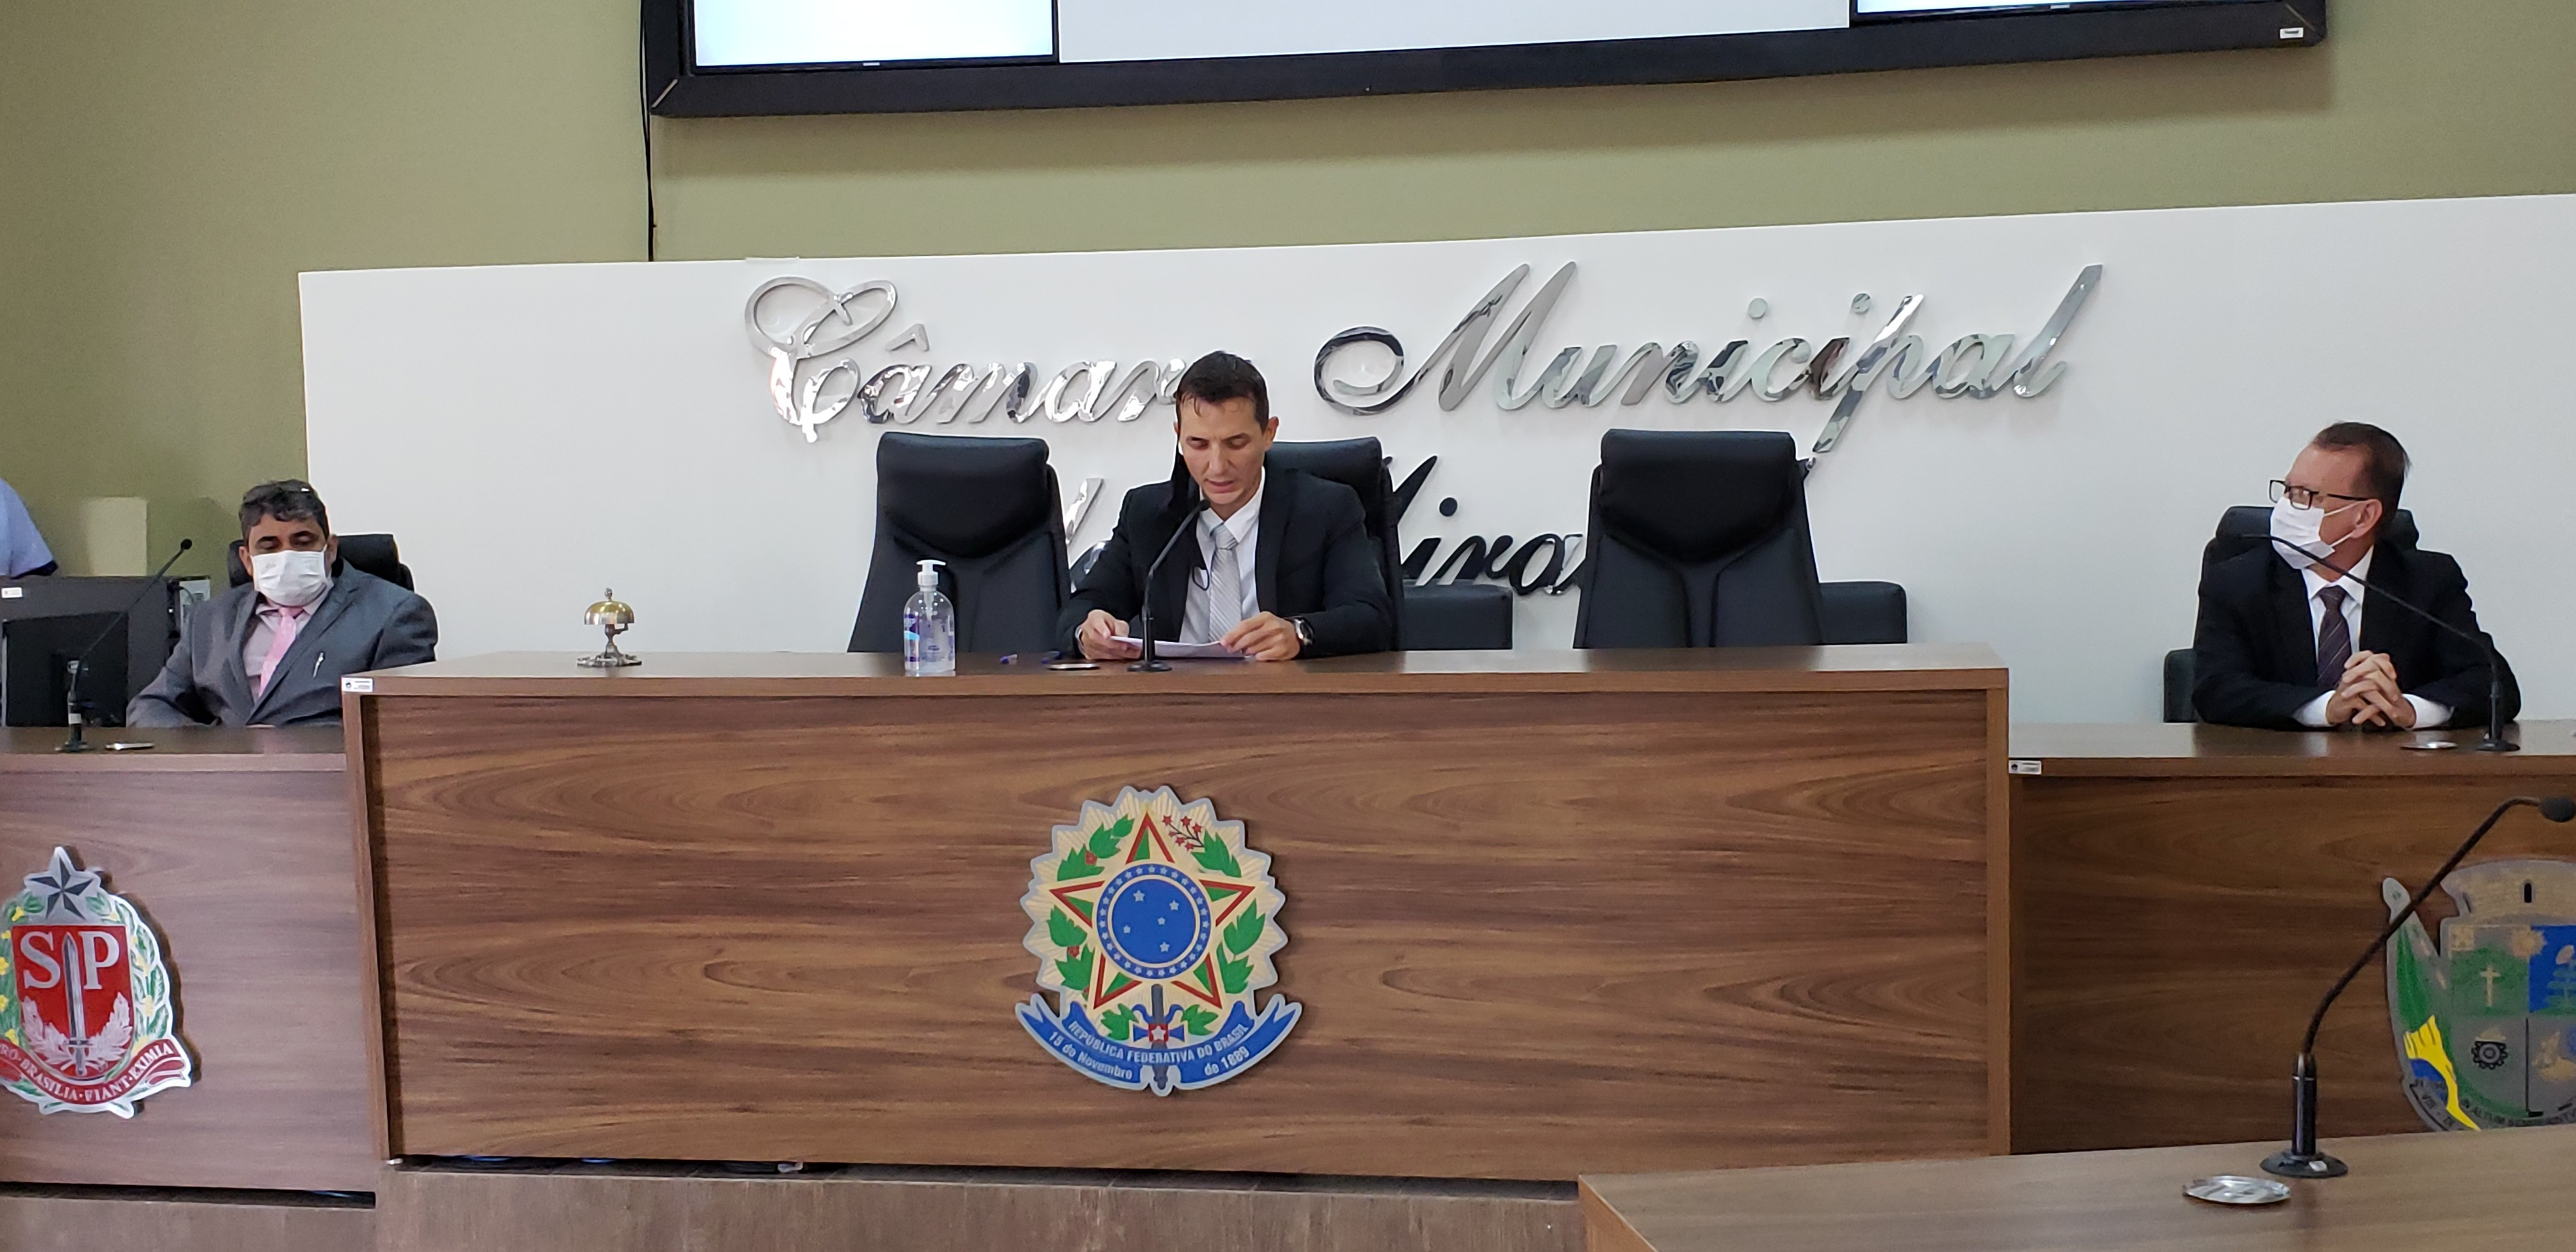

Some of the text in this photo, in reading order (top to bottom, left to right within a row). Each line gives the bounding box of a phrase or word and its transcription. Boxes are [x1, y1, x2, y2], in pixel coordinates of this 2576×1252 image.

[745, 261, 2103, 454] Câmar Municipal
[1049, 1031, 1250, 1080] 15 de Novembro de 1889
[1126, 1048, 1195, 1064] FEDERATIVA
[1197, 1044, 1213, 1059] DO
[1214, 1023, 1250, 1052] BRASIL
